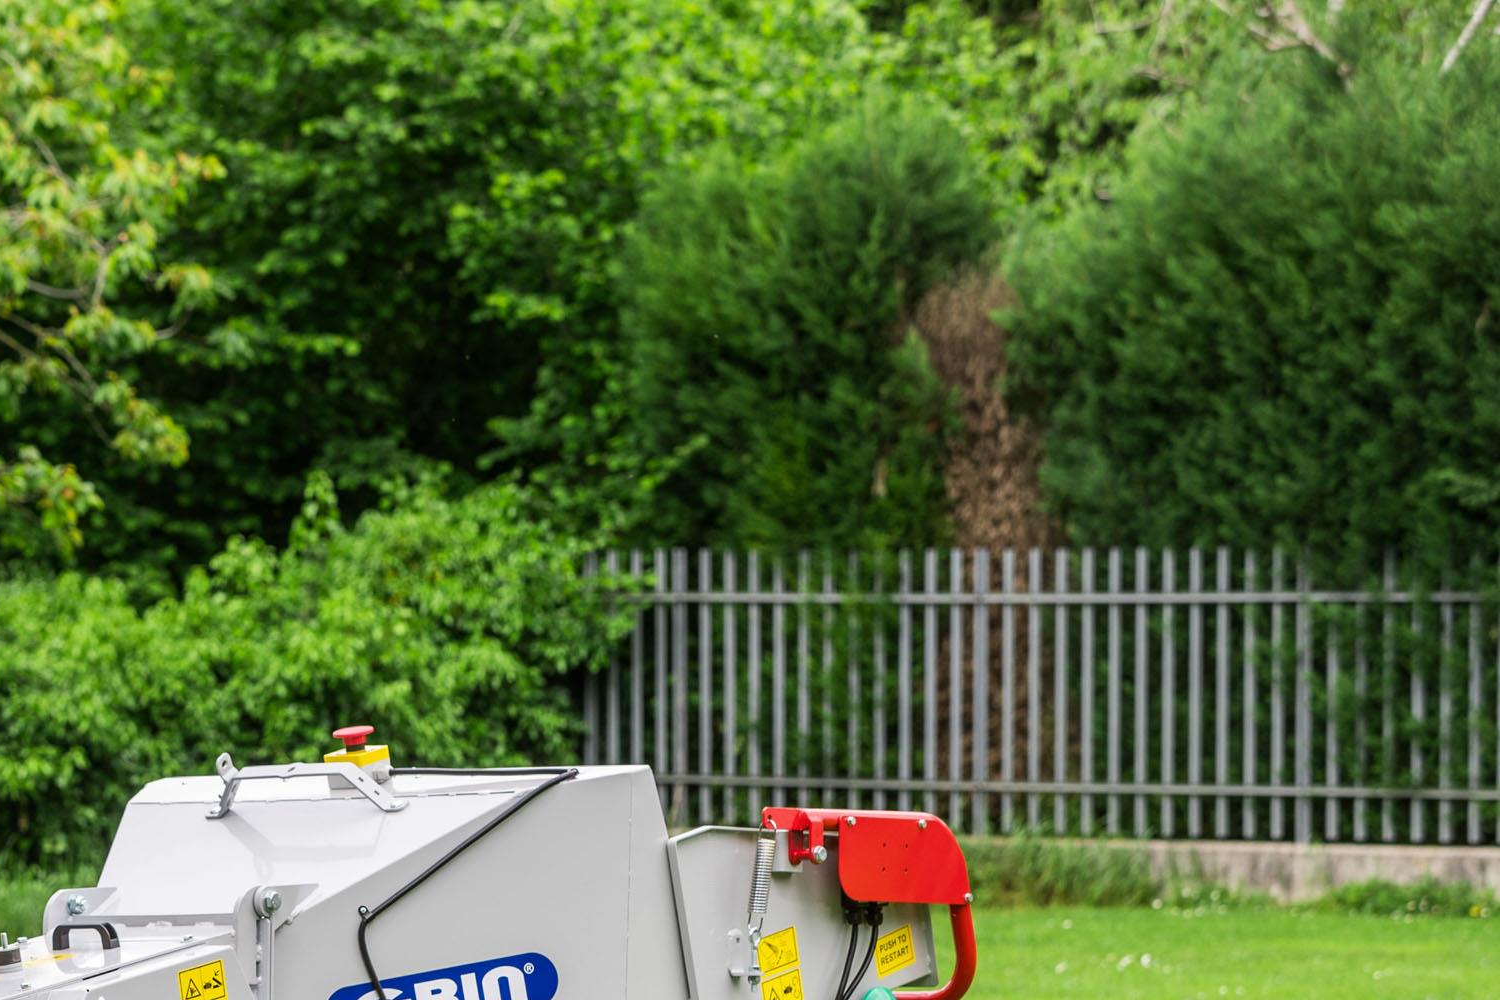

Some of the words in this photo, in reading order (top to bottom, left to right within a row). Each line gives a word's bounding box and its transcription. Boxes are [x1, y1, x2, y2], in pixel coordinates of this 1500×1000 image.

[879, 940, 896, 953] PUSH
[898, 934, 907, 944] TO
[881, 945, 908, 966] RESTART
